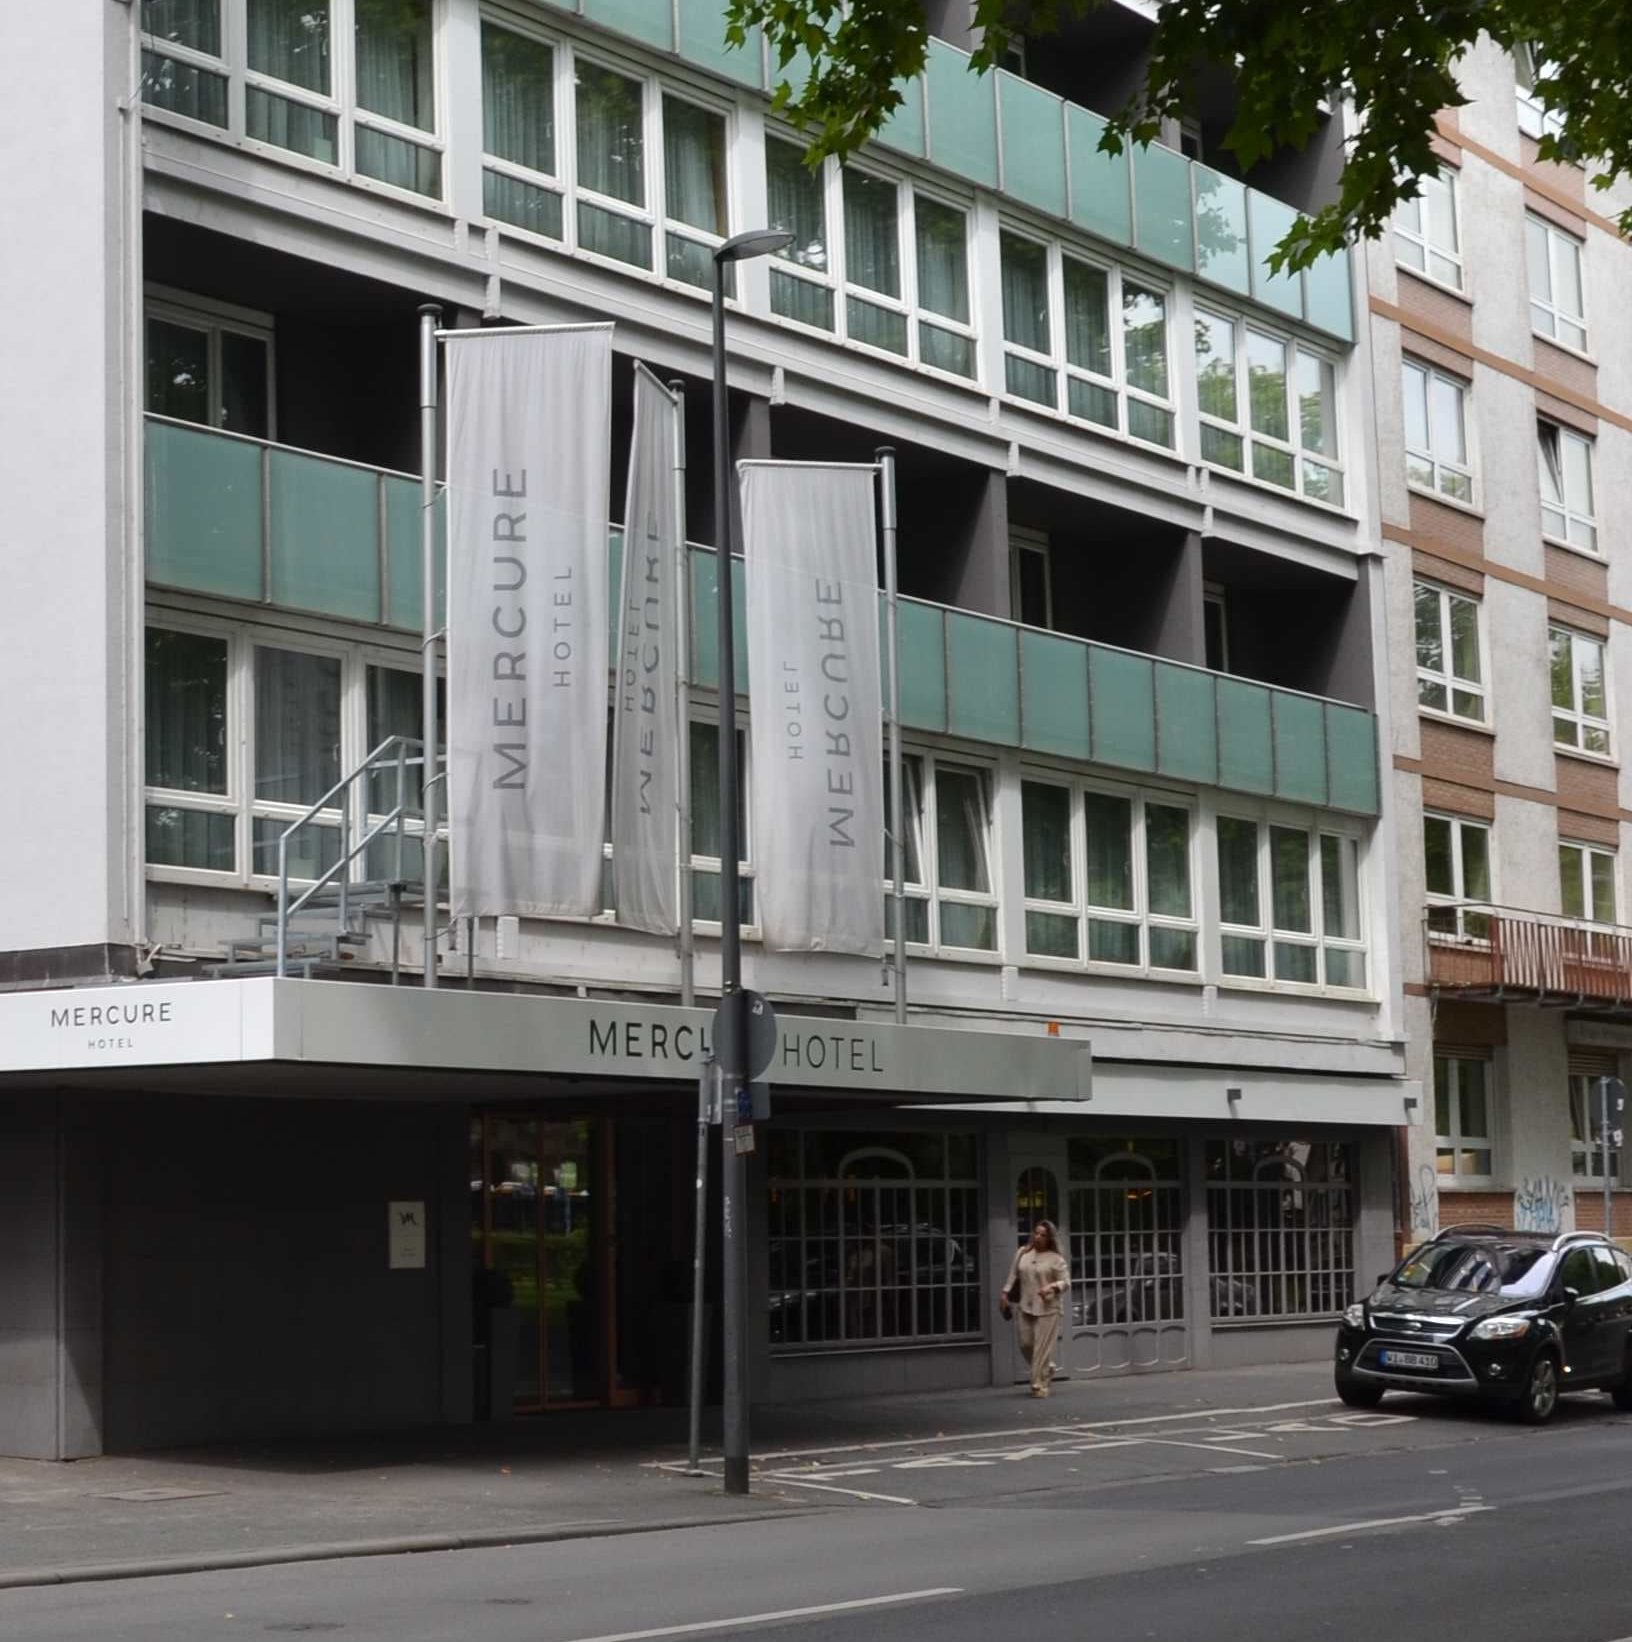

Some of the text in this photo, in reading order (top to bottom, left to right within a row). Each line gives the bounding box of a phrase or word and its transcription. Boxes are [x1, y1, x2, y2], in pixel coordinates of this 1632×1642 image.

[492, 468, 528, 790] MERCURE
[553, 566, 573, 688] HOTEL
[50, 1002, 172, 1027] MERCURE
[87, 1038, 134, 1049] HOTEL
[589, 1019, 884, 1072] MERC HOTEL
